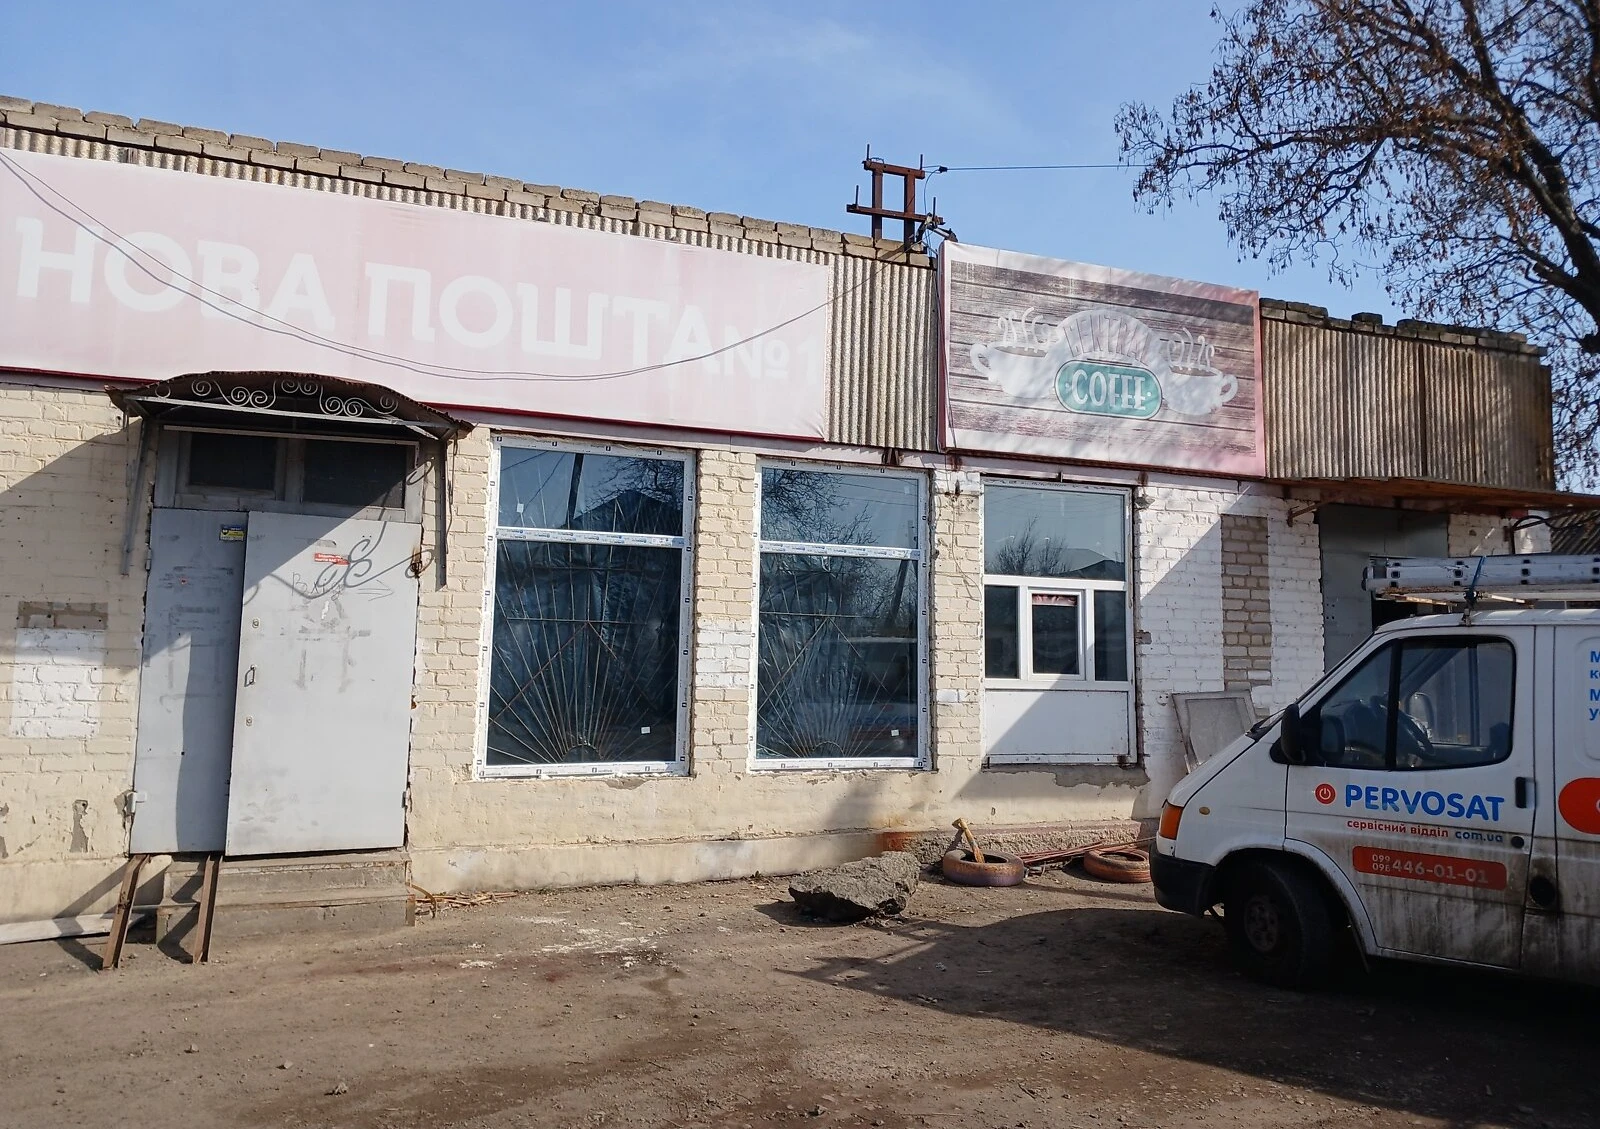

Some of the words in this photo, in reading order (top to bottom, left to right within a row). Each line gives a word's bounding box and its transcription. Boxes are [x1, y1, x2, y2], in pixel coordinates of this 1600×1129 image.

[15, 214, 336, 333] НОВА
[364, 261, 721, 377] ПОШТА
[1345, 784, 1505, 822] PERVOSAT
[1347, 819, 1407, 834] сервісний
[1410, 825, 1449, 838] відділ
[1455, 829, 1504, 843] com.ua
[1392, 859, 1489, 884] 446-01-01
